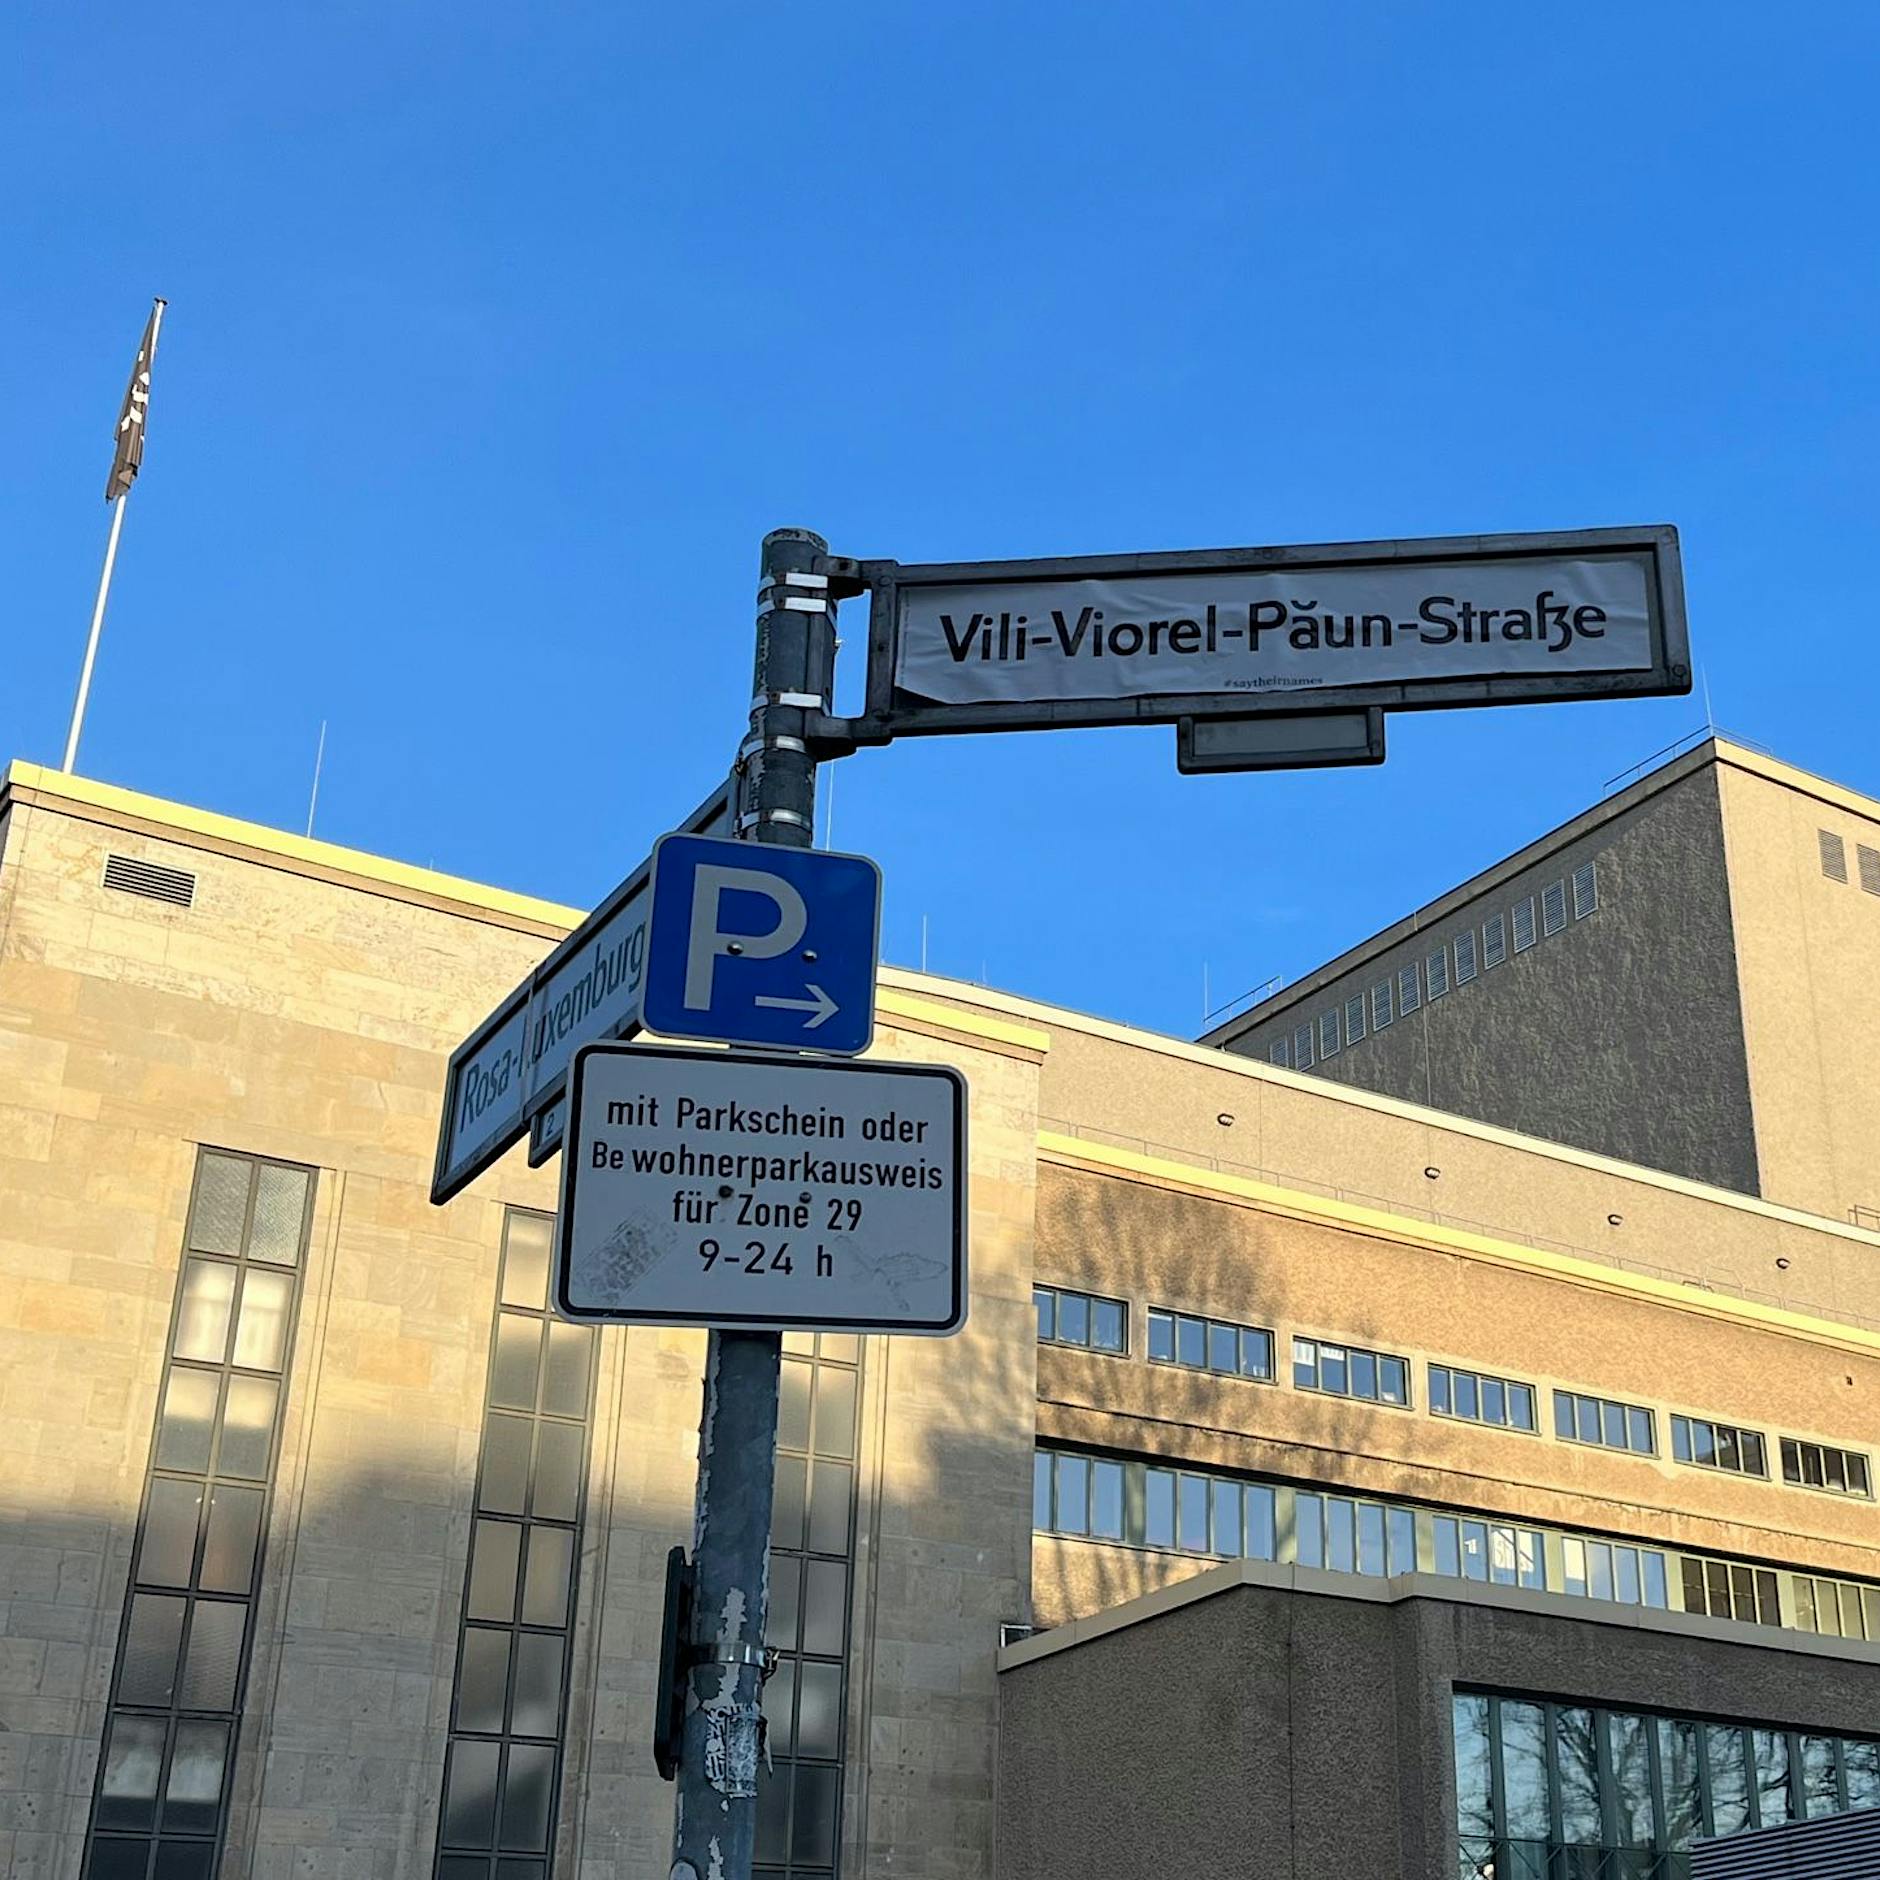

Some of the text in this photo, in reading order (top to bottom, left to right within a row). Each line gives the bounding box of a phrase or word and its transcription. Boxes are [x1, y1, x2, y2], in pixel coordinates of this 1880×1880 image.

[940, 591, 1606, 662] Vili-Viorel-Păun-Straße
[684, 863, 807, 1011] P
[607, 1094, 929, 1143] mit Parkschein oder
[673, 1190, 863, 1231] für Zone 29
[699, 1239, 833, 1277] 9-24 h
